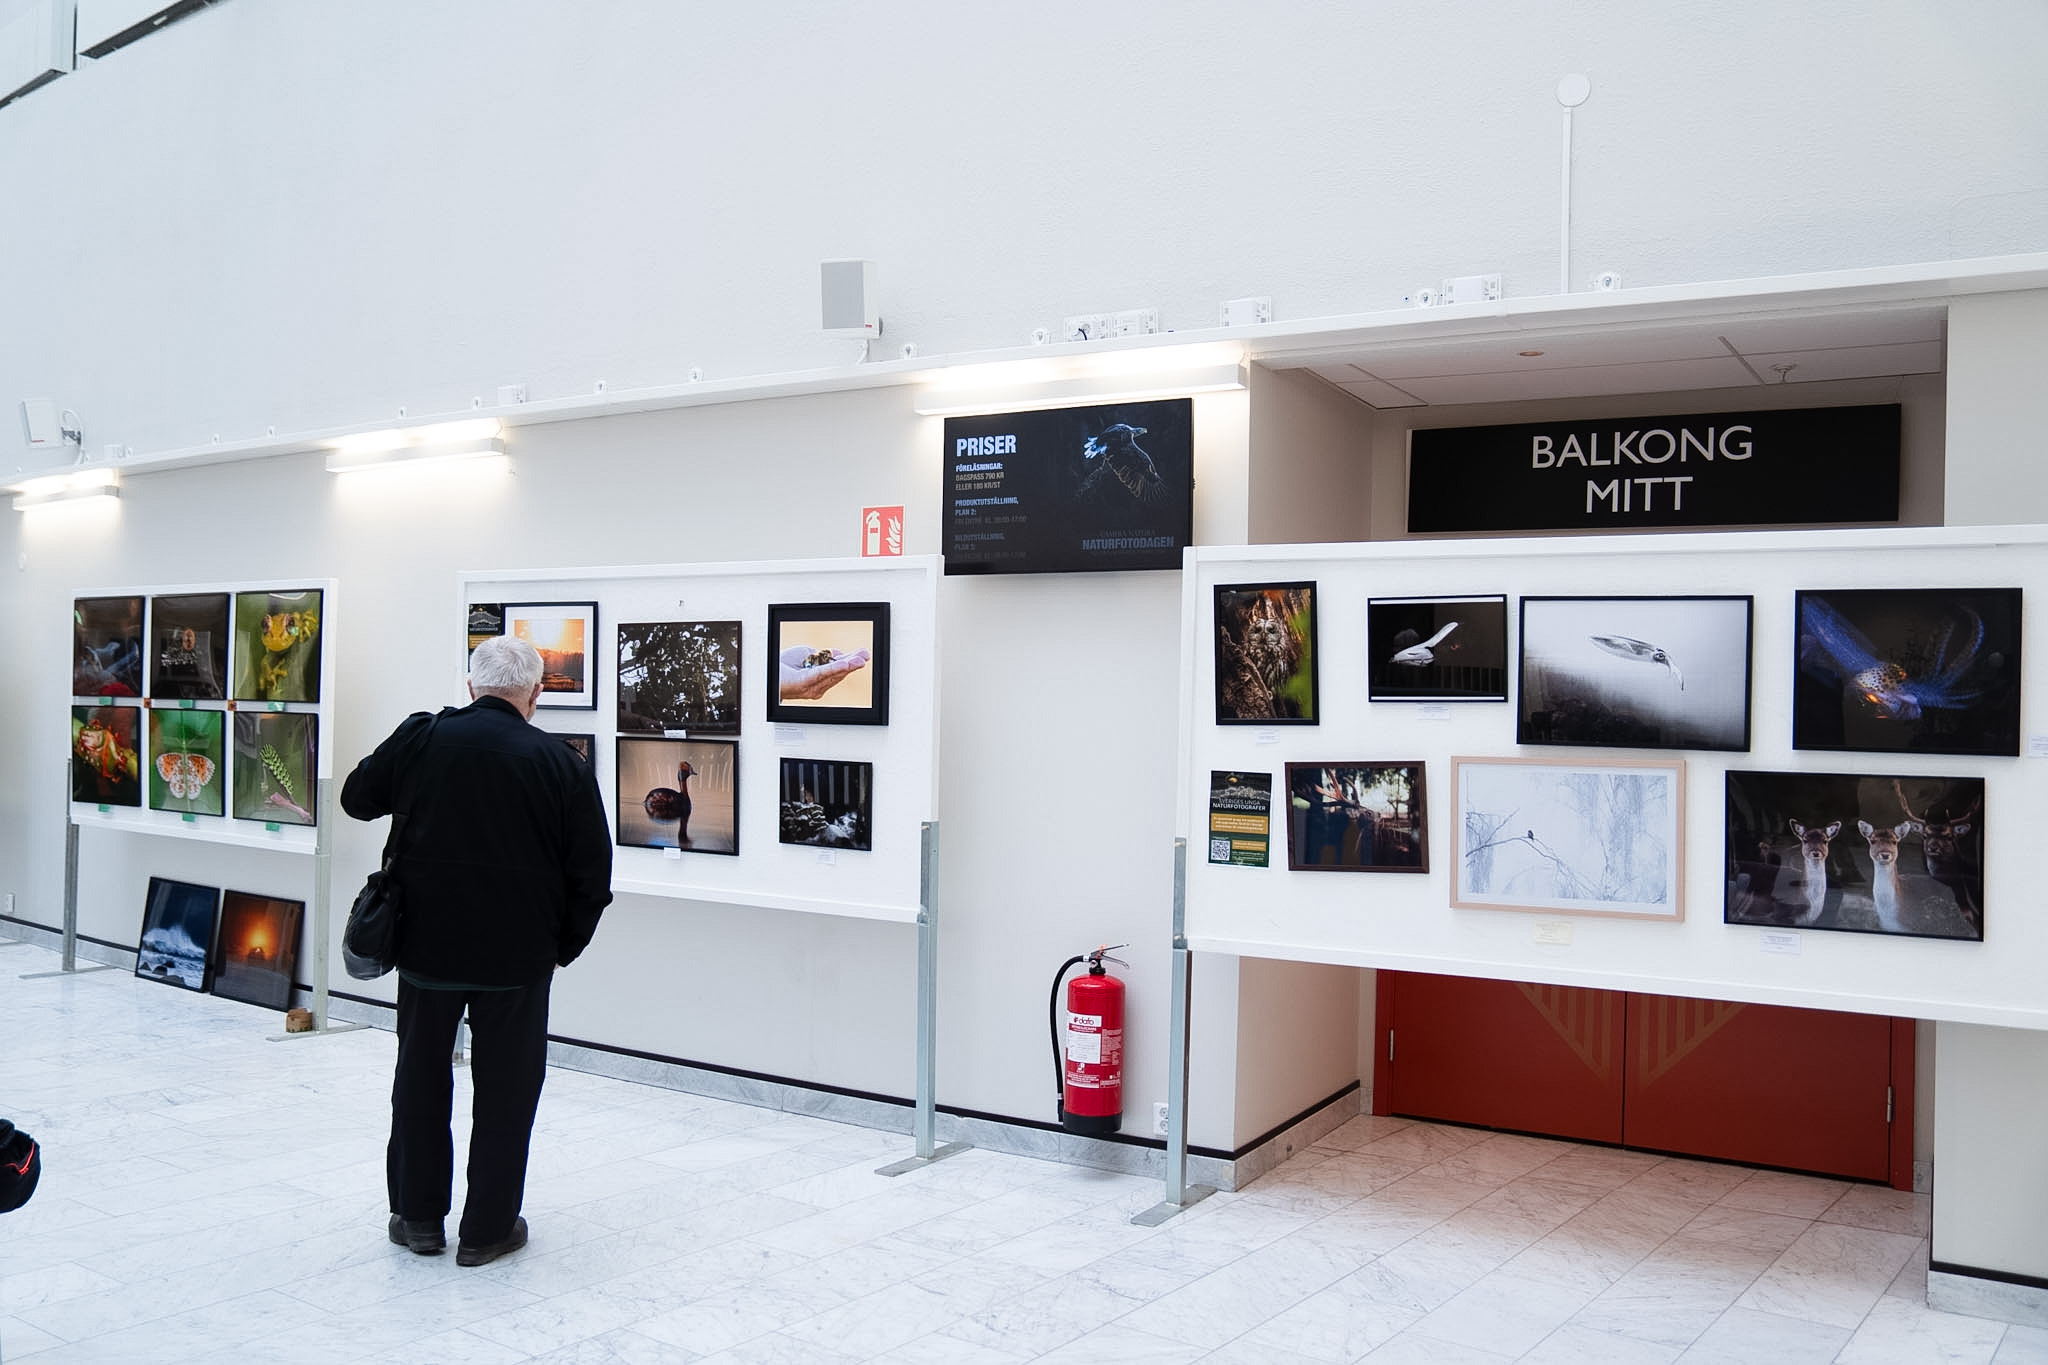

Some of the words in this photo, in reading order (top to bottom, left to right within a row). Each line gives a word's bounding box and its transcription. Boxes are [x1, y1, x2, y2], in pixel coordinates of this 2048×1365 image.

[956, 434, 1017, 457] PRISER
[1532, 425, 1753, 469] BALKONG
[955, 473, 985, 482] DAGSPASS
[955, 483, 972, 491] ELLER
[1586, 476, 1693, 514] MITT
[955, 509, 969, 517] PLAN
[1082, 536, 1175, 551] NATURFOTODAGEN
[1212, 802, 1266, 811] NATURFOTOGRAFER
